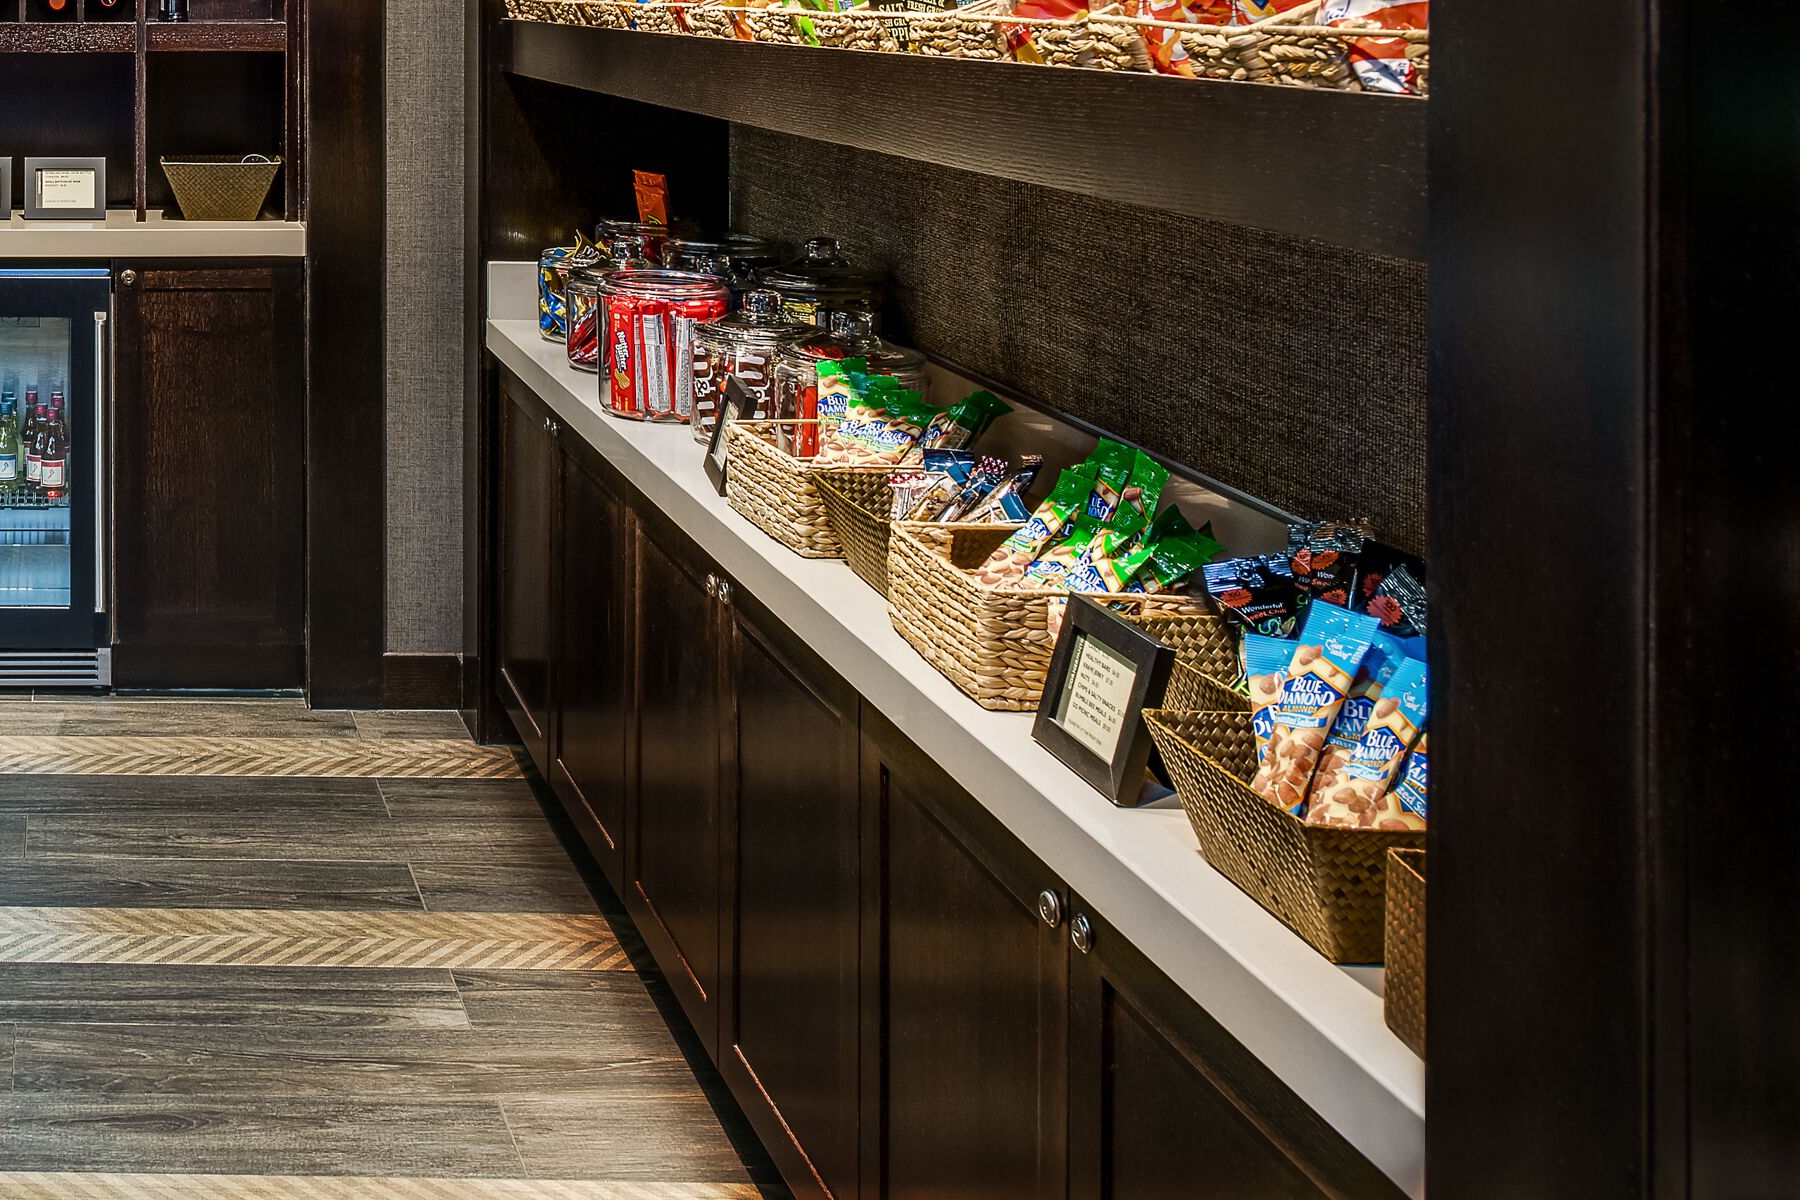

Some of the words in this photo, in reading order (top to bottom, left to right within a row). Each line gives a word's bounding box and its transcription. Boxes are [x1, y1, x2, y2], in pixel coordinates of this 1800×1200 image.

[1241, 602, 1283, 614] Wonderful
[1083, 662, 1094, 673] KRAVE
[1086, 653, 1101, 665] HEALTHY
[1101, 662, 1111, 672] BARS
[1080, 672, 1090, 681] NUTS
[1291, 676, 1323, 695] BLUE
[1078, 682, 1087, 693] CHIPS
[1102, 698, 1116, 712] SNACKS
[1279, 691, 1335, 706] DIAMOND
[1095, 706, 1107, 718] MEALS
[1090, 713, 1101, 726] MEALS
[1366, 729, 1396, 748] BLUE
